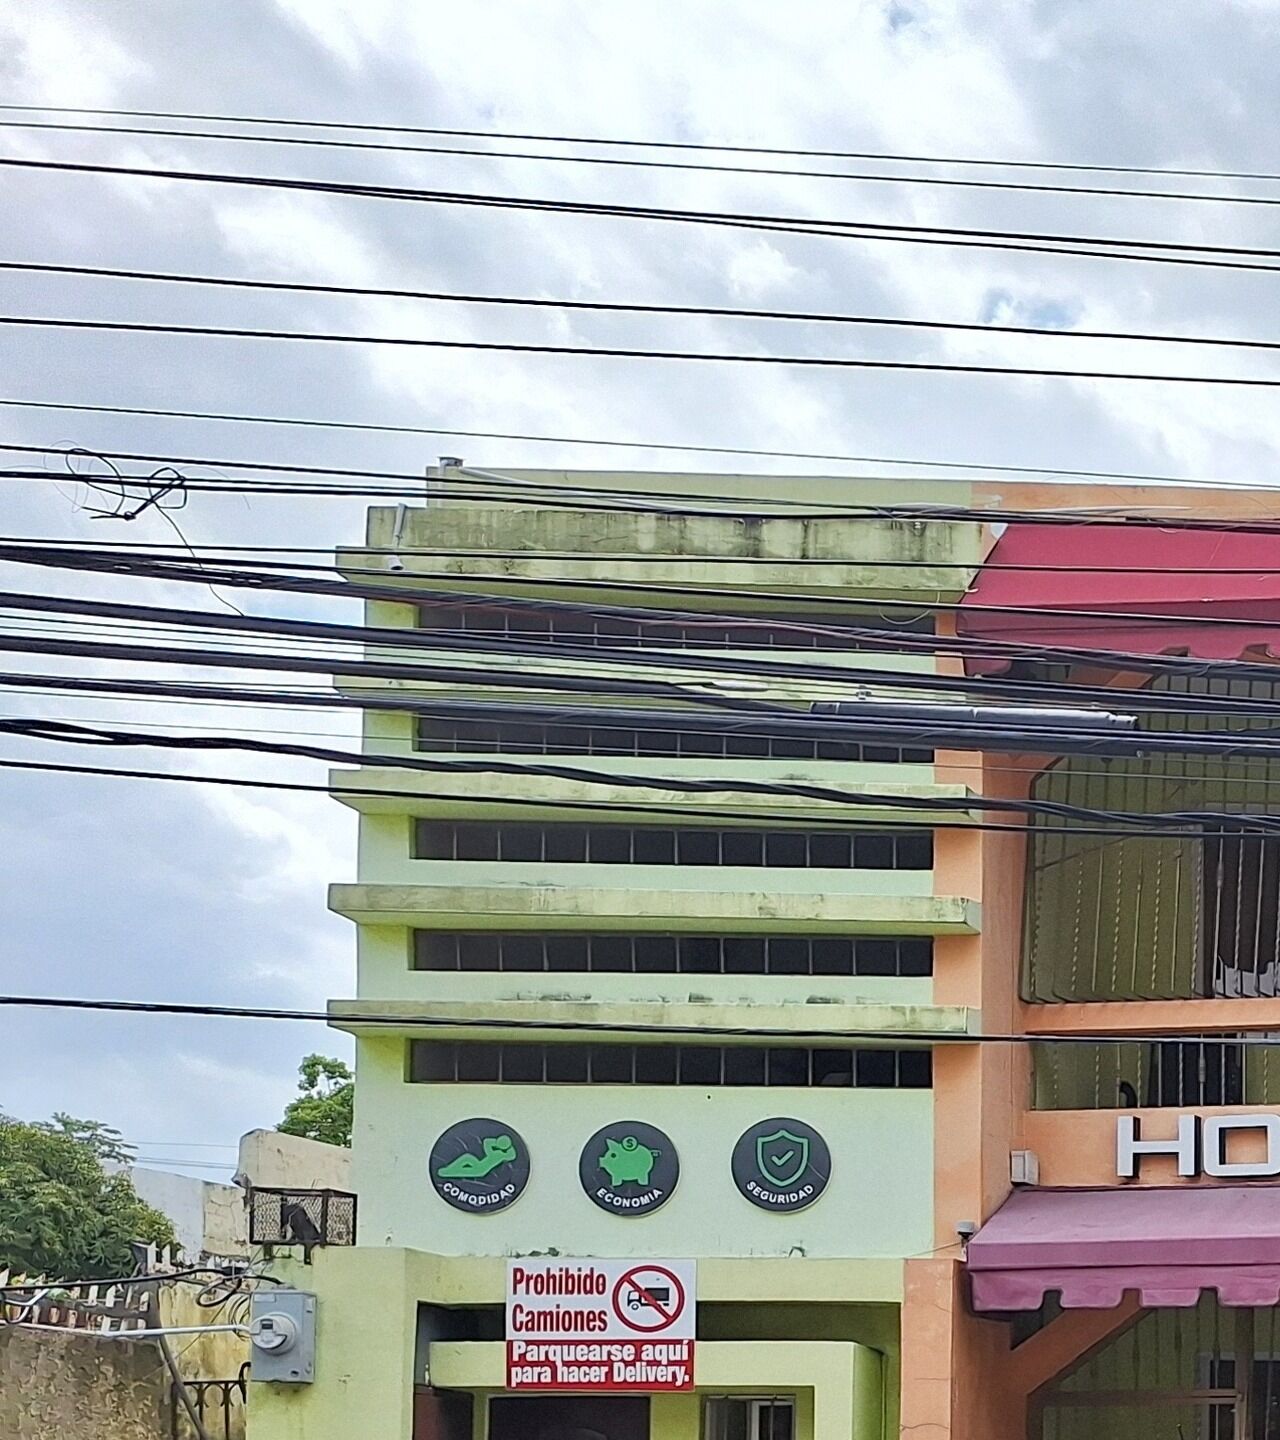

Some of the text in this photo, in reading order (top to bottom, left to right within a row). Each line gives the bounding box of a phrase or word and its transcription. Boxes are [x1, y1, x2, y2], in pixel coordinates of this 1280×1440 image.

[443, 1182, 516, 1206] COMODIDAD
[596, 1187, 663, 1208] ECONOMIA
[746, 1181, 814, 1204] SEGURIDAD
[512, 1266, 607, 1296] Prohibido
[512, 1303, 608, 1333] Camiones
[511, 1339, 689, 1366] Parquearse aquí
[510, 1361, 690, 1388] para hacer Delivery.
